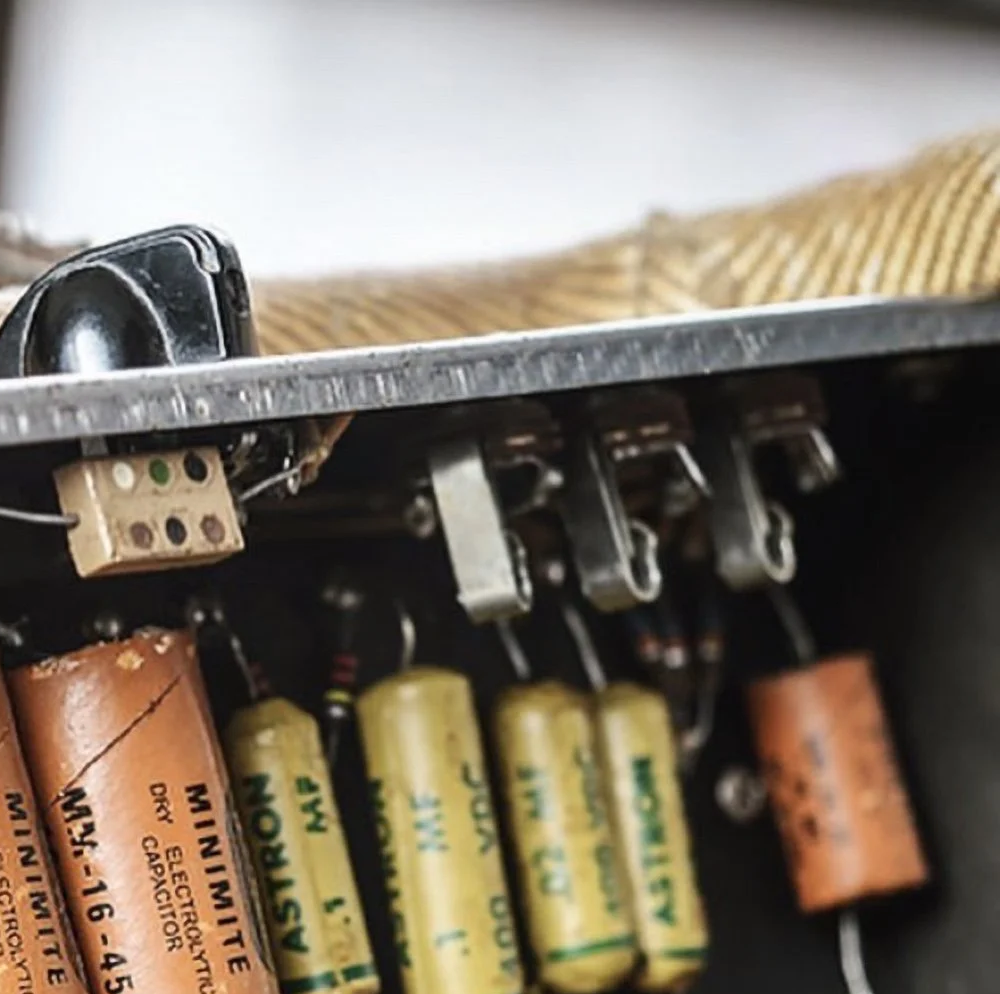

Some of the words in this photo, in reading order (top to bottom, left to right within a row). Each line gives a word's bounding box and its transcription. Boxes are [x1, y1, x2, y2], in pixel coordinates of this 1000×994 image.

[5, 791, 67, 986] MINIMITE
[141, 835, 184, 952] CAPACITOR
[150, 782, 174, 825] DRY
[185, 782, 251, 975] MINIMITE
[243, 772, 309, 954] ASTRON
